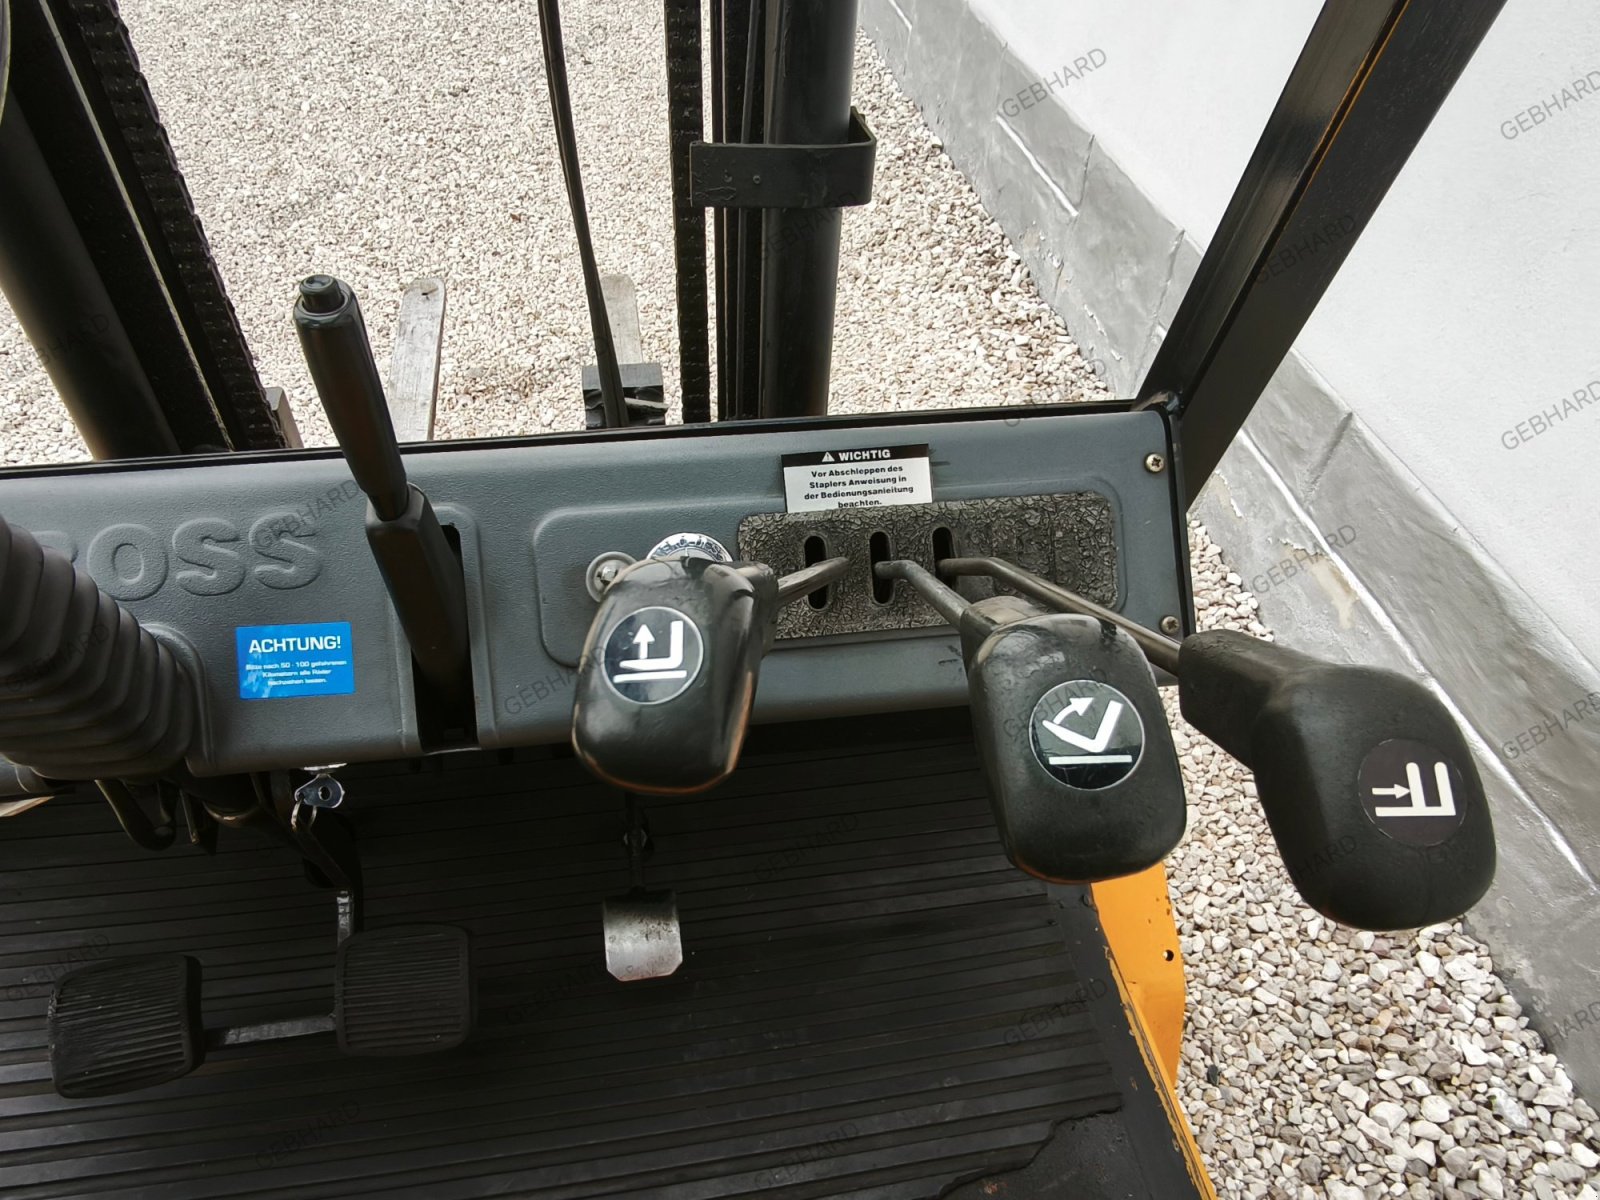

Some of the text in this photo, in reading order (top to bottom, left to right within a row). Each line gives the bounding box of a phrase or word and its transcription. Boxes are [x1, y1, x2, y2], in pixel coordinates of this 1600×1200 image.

[838, 449, 891, 462] WICHTIG
[811, 465, 903, 478] Vor Abschleppen des
[809, 481, 847, 490] Staplers
[848, 477, 897, 486] Anweisung
[820, 485, 914, 499] Bedienungsanleitung
[837, 499, 883, 508] beachten.
[30, 511, 322, 601] OSS
[248, 635, 341, 653] ACHTUNG!
